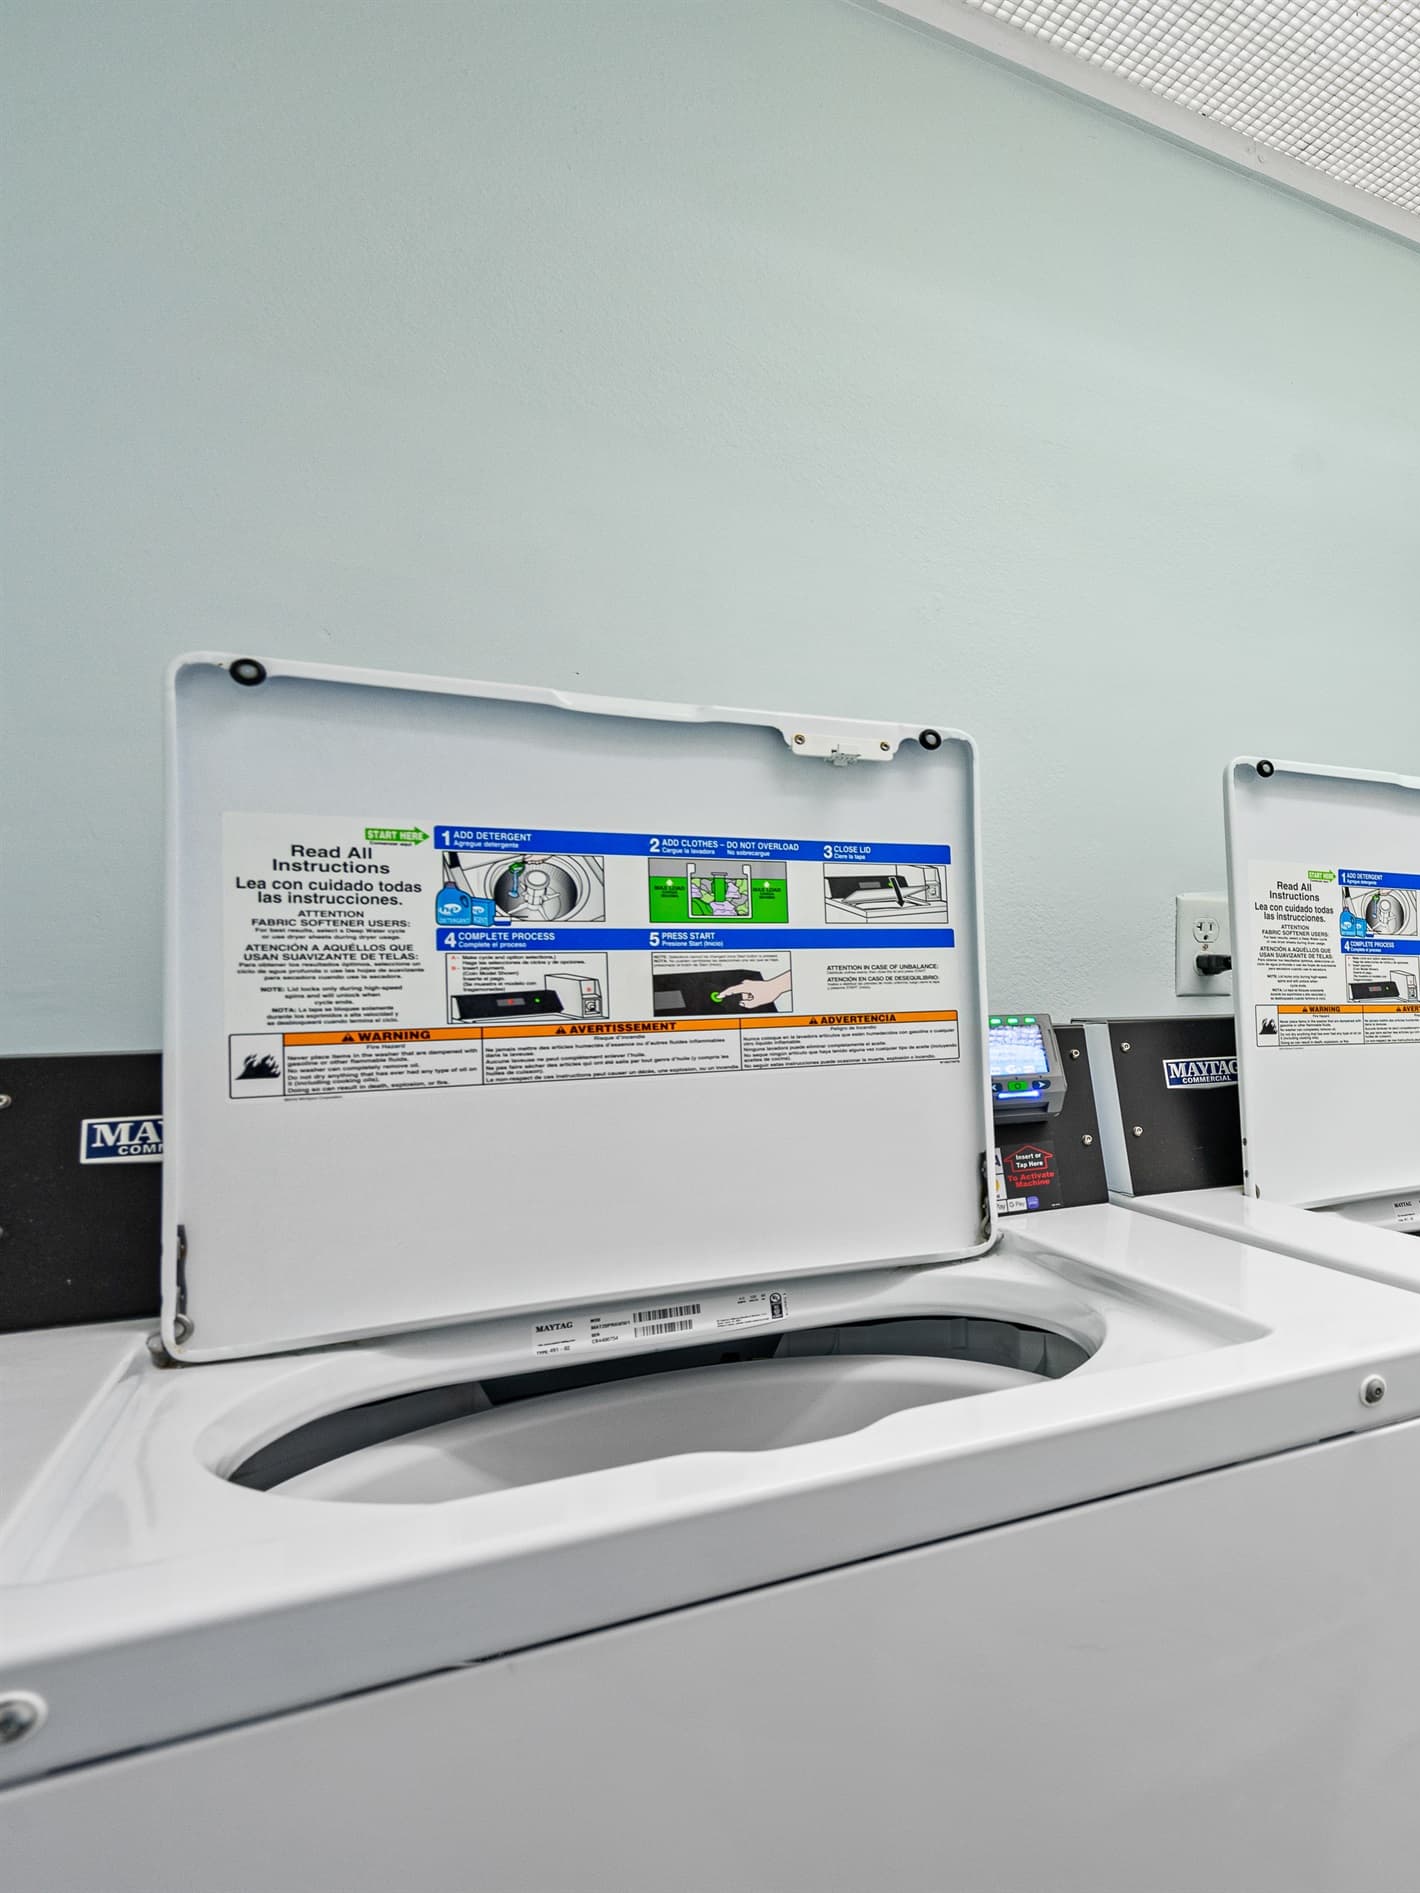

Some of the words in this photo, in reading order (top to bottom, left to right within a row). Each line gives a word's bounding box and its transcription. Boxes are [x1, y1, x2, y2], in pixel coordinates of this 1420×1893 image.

[368, 830, 396, 840] START
[400, 831, 424, 841] HERE
[442, 830, 450, 846] 1
[454, 831, 473, 840] ADD
[476, 832, 532, 842] DETERGENT
[454, 840, 482, 848] Agregue
[484, 841, 519, 850] detergente
[650, 838, 660, 852] 2
[662, 839, 679, 847] ADD
[681, 840, 718, 848] CLOTHES
[740, 842, 754, 850] NOT
[757, 842, 800, 851] OVERLOAD
[291, 844, 340, 858] Read
[348, 847, 372, 859] All
[824, 845, 832, 858] 3
[834, 846, 858, 854] CLOSE
[860, 846, 871, 854] LID
[272, 859, 390, 874] Instructions
[1342, 872, 1346, 883] 1
[236, 877, 266, 890] Lea
[272, 880, 303, 890] con
[308, 878, 374, 892] cuidado
[379, 880, 422, 892] todas
[1277, 881, 1298, 890] Read
[1301, 883, 1312, 891] All
[258, 892, 282, 904] las
[288, 892, 402, 906] instrucciones.
[1270, 890, 1320, 902] Instructions
[1254, 902, 1268, 910] Lea
[1285, 904, 1313, 913] cuidado
[1315, 906, 1334, 914] todas
[298, 910, 364, 918] ATTENTION
[1264, 912, 1275, 920] las
[1277, 912, 1326, 922] instrucciones.
[251, 918, 296, 926] FABRIC
[300, 919, 364, 927] SOFTENER
[368, 920, 411, 928] USERS:
[444, 932, 456, 948] 4
[458, 932, 509, 940] COMPLETE
[512, 932, 556, 940] PROCESS
[650, 932, 660, 946] 5
[662, 932, 688, 940] PRESS
[690, 932, 716, 940] START
[245, 942, 308, 952] ATENCIÓN
[389, 944, 414, 952] QUE
[458, 941, 491, 949] Complete
[1344, 940, 1350, 952] 4
[243, 953, 279, 961] USAN
[380, 952, 419, 960] TELAS:
[820, 1014, 896, 1024] ADVERTENCIA
[570, 1022, 677, 1034] AVERTISSEMENT
[358, 1030, 431, 1042] WARNING
[1168, 1060, 1238, 1078] MAYTAG
[1182, 1075, 1231, 1084] COMMERCIAL
[1021, 1172, 1054, 1180] Activate
[1016, 1180, 1050, 1188] Machine
[536, 1322, 573, 1333] MAYTAG
